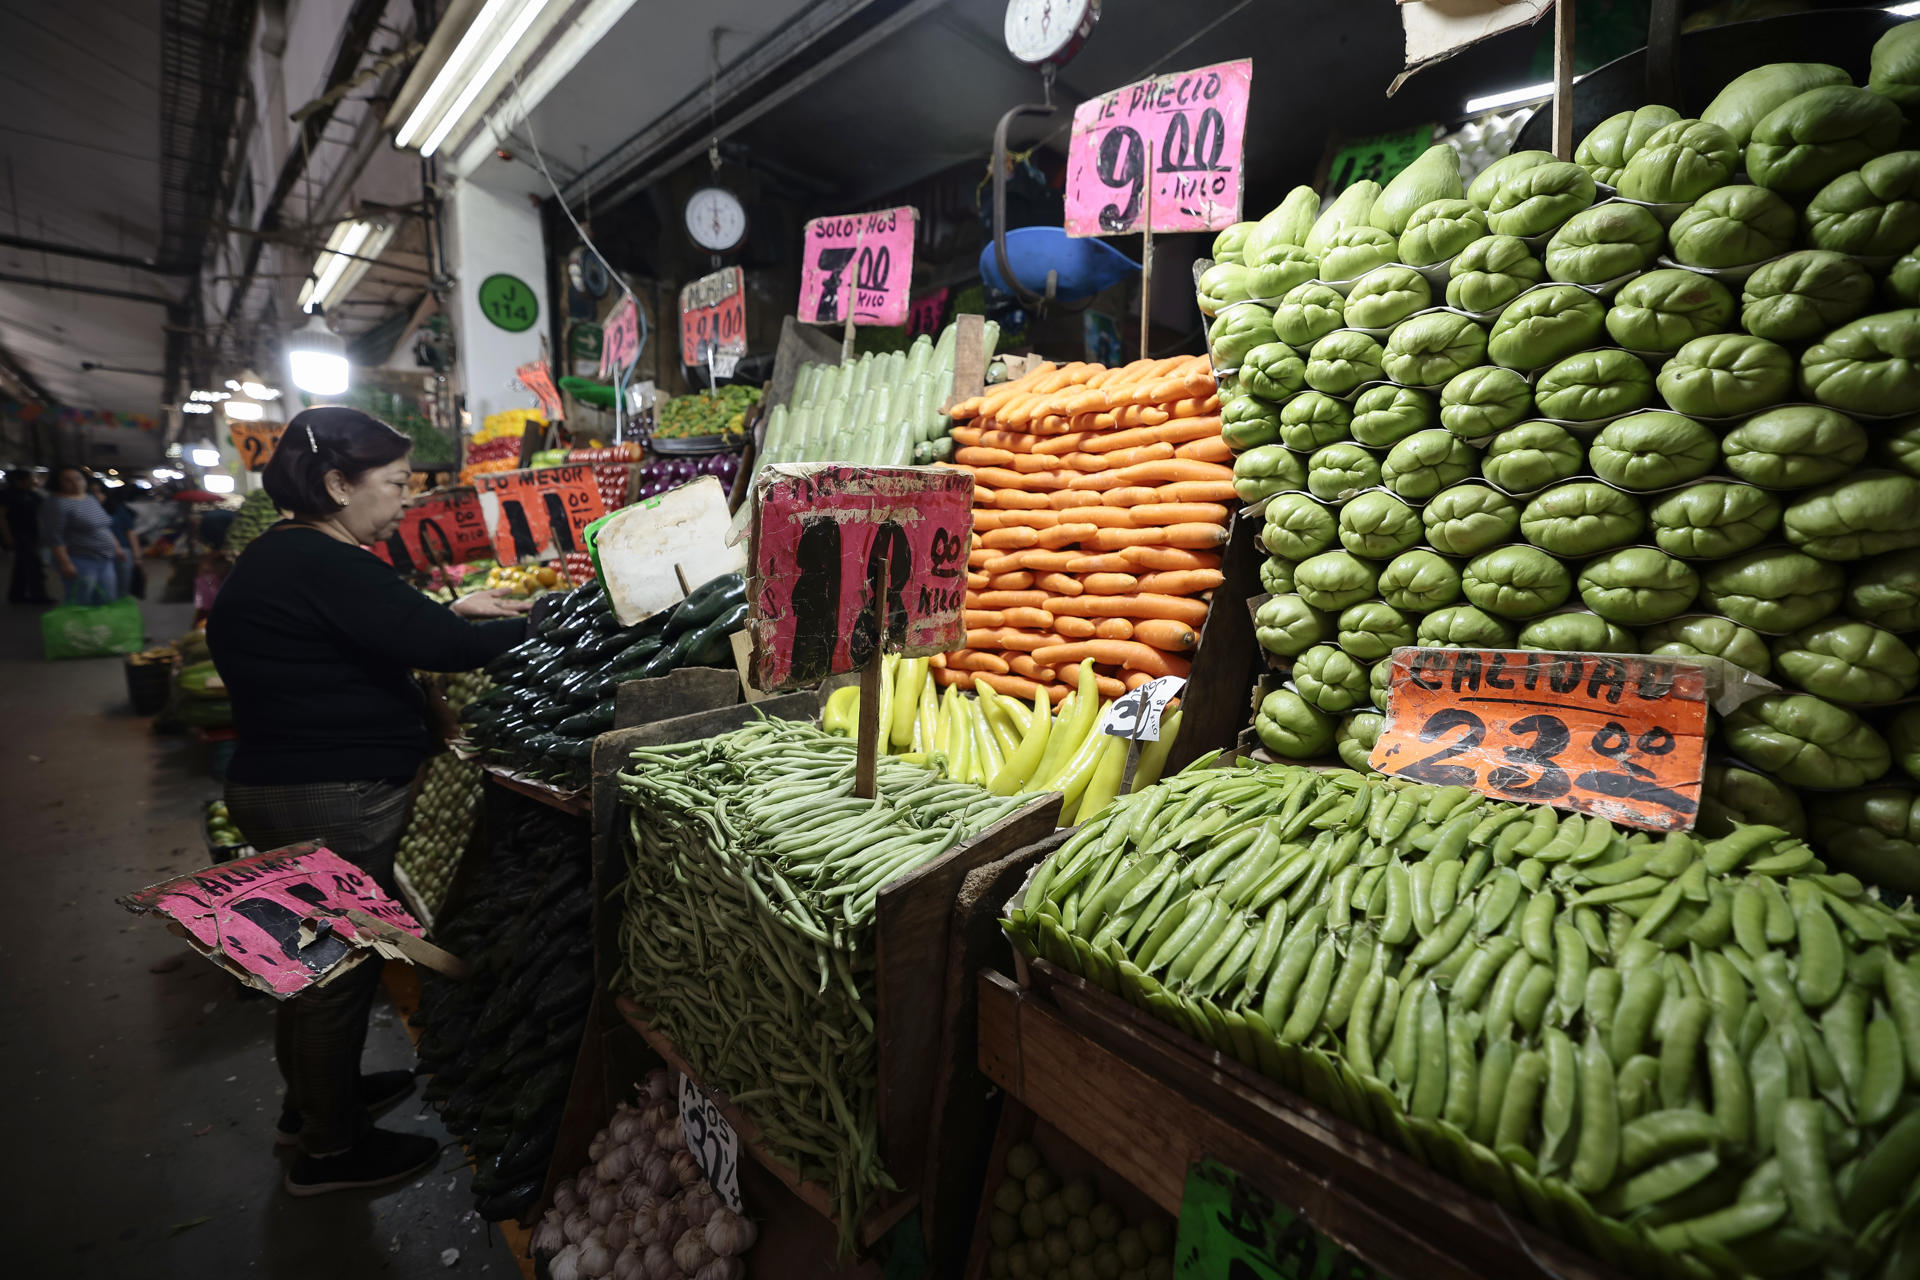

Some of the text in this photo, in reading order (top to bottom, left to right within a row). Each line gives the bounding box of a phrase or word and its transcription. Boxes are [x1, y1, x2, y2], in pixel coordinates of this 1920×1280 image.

[1128, 72, 1222, 117] PRECIO
[1096, 125, 1146, 232] 9
[491, 301, 528, 321] 114
[502, 285, 516, 302] J
[484, 465, 583, 491] LO MEJOR
[1410, 651, 1675, 704] CALIDAD
[1398, 708, 1571, 800] 23
